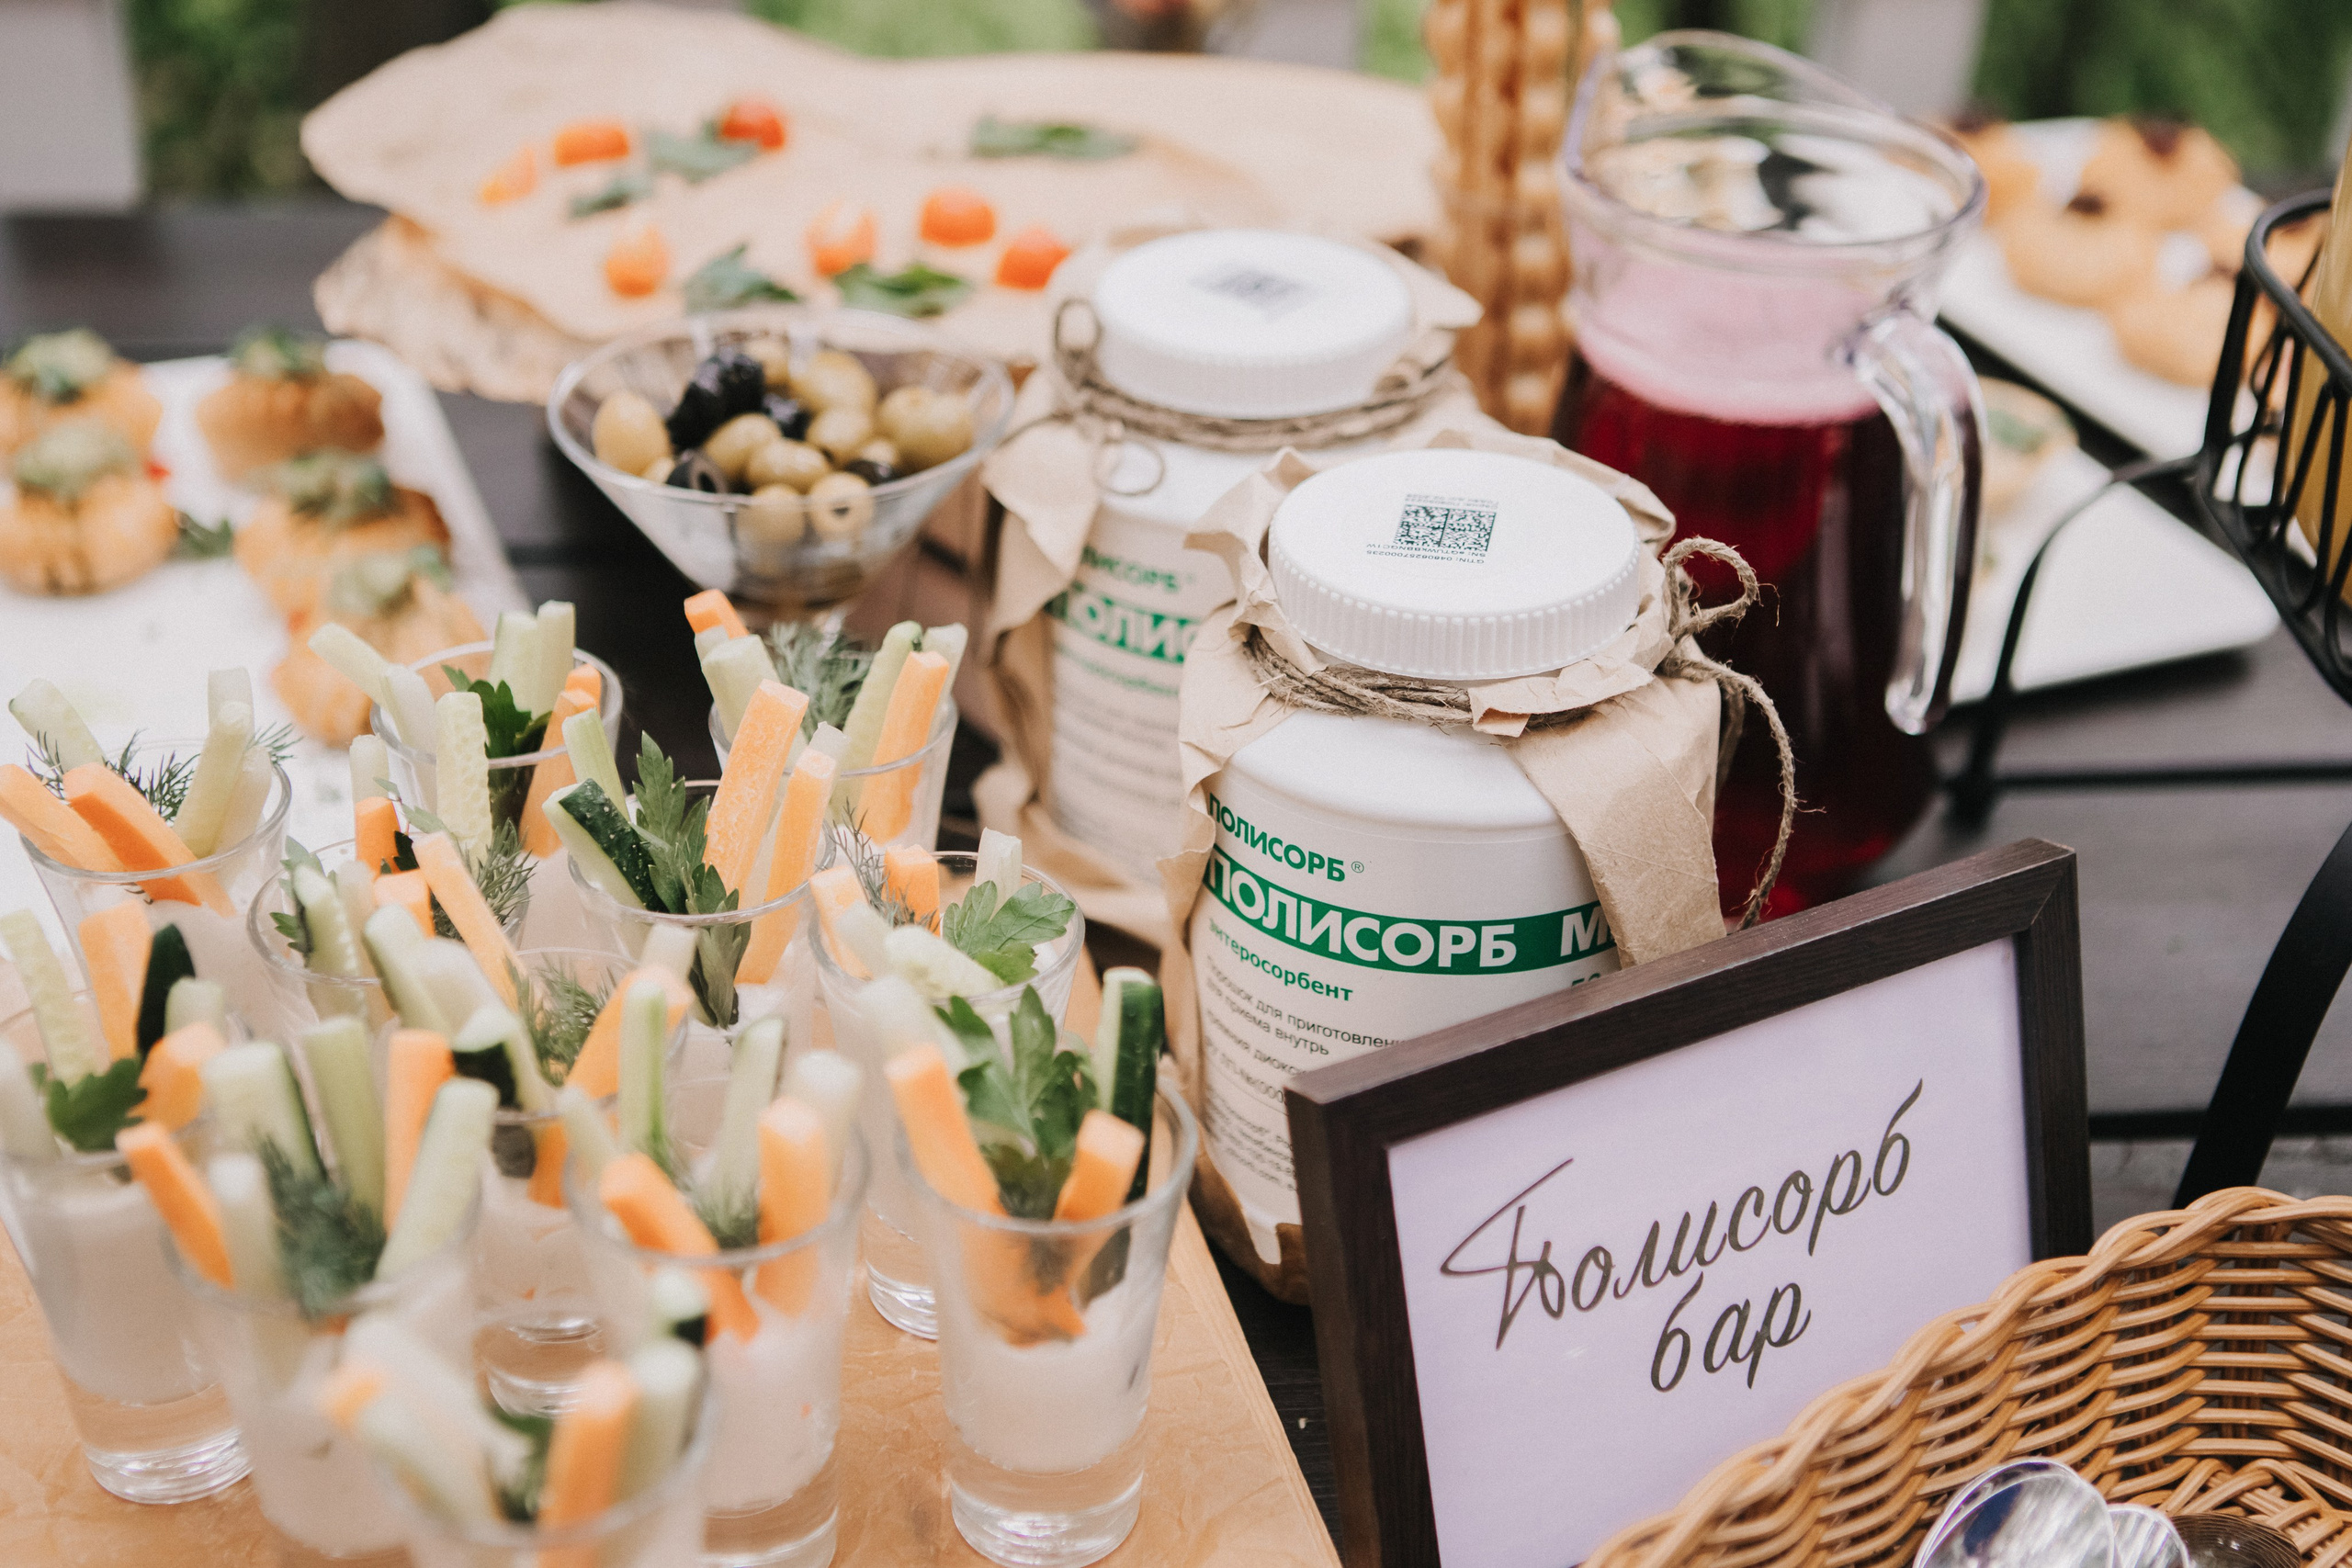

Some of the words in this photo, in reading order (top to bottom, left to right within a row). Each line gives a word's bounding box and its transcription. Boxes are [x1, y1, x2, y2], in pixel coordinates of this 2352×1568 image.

[1207, 855, 1518, 969] ПОЛИСОРБ
[1256, 999, 1283, 1021] для
[1287, 1013, 1405, 1049] приготовлен
[1274, 1027, 1330, 1056] внутрь
[1439, 1077, 1923, 1351] Полисорб
[1650, 1271, 1812, 1393] бар
